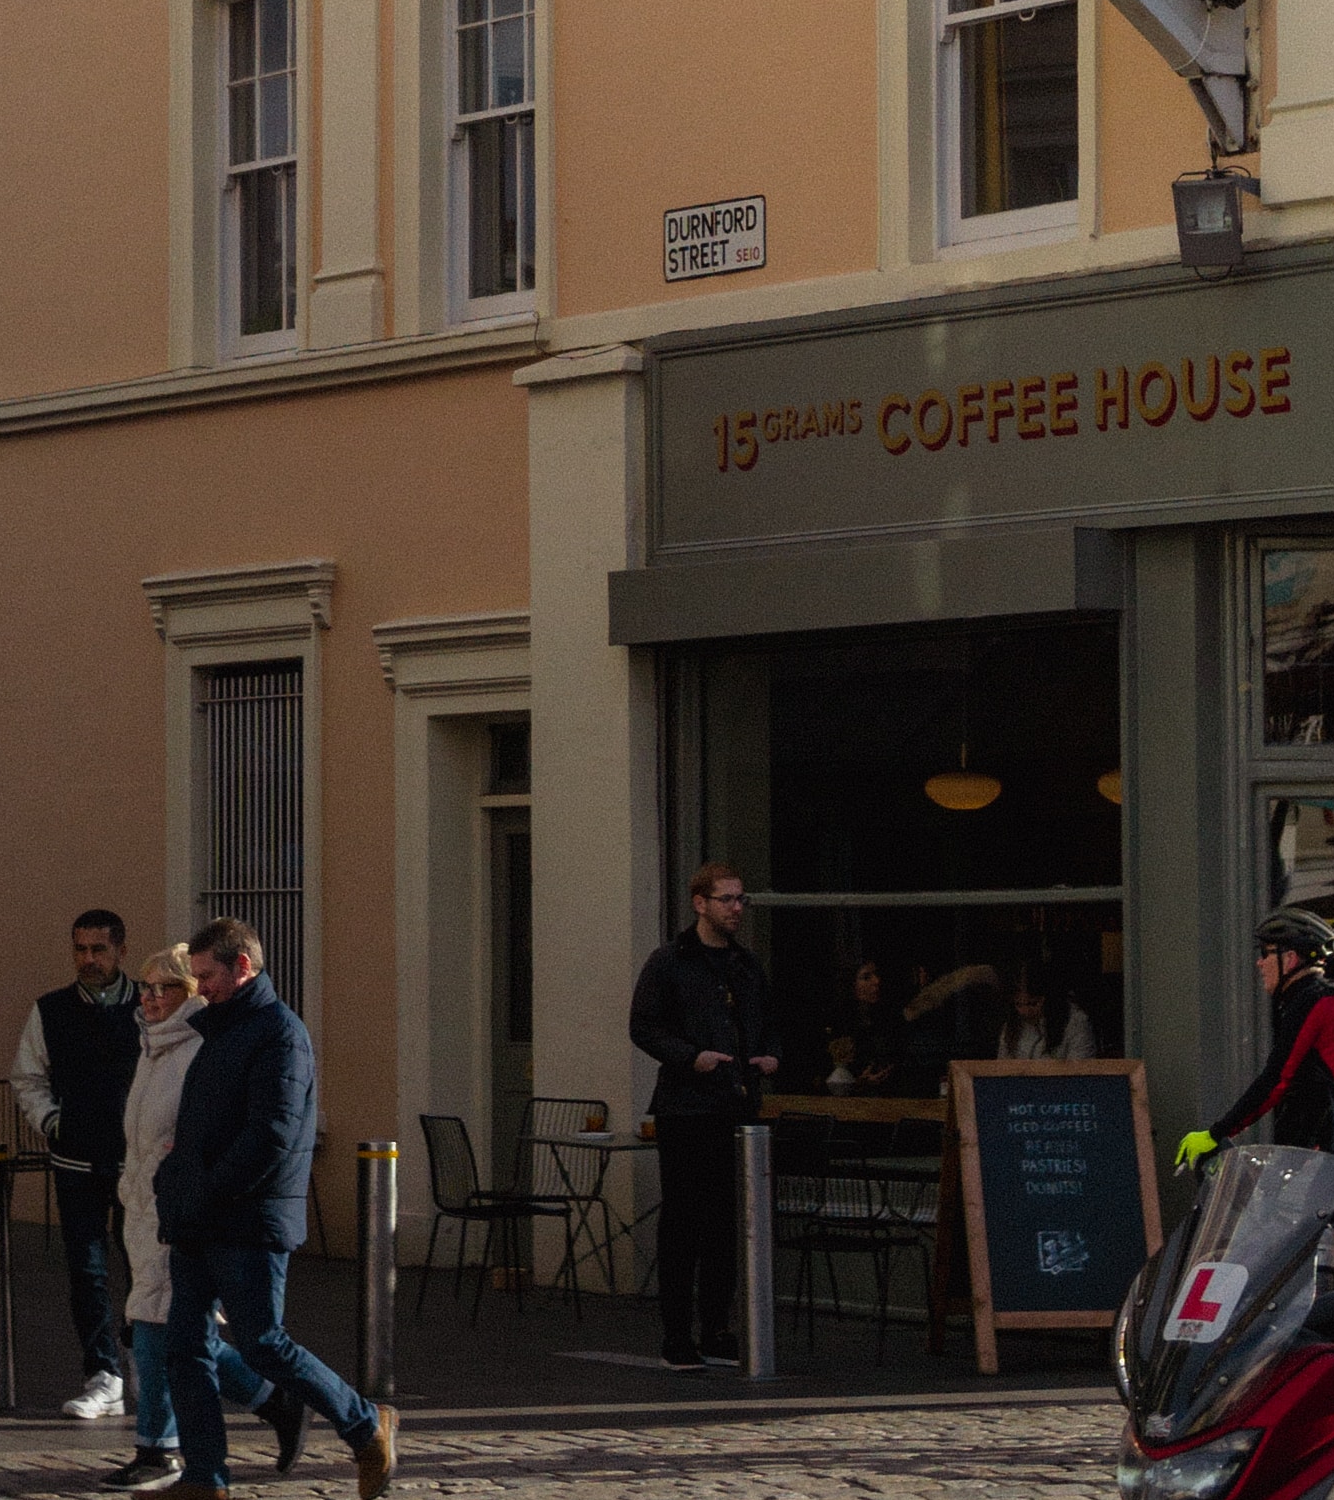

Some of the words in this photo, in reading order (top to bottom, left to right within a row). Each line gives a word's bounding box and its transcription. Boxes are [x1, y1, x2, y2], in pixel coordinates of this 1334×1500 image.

[668, 204, 757, 244] DURNFORD
[668, 239, 729, 273] STREET
[713, 410, 760, 472] 15
[762, 399, 862, 443] GRAMS
[876, 372, 1079, 456] COFFEE
[1094, 347, 1292, 430] HOUSE
[1008, 1103, 1035, 1116] HOT
[1177, 1268, 1222, 1323] L
